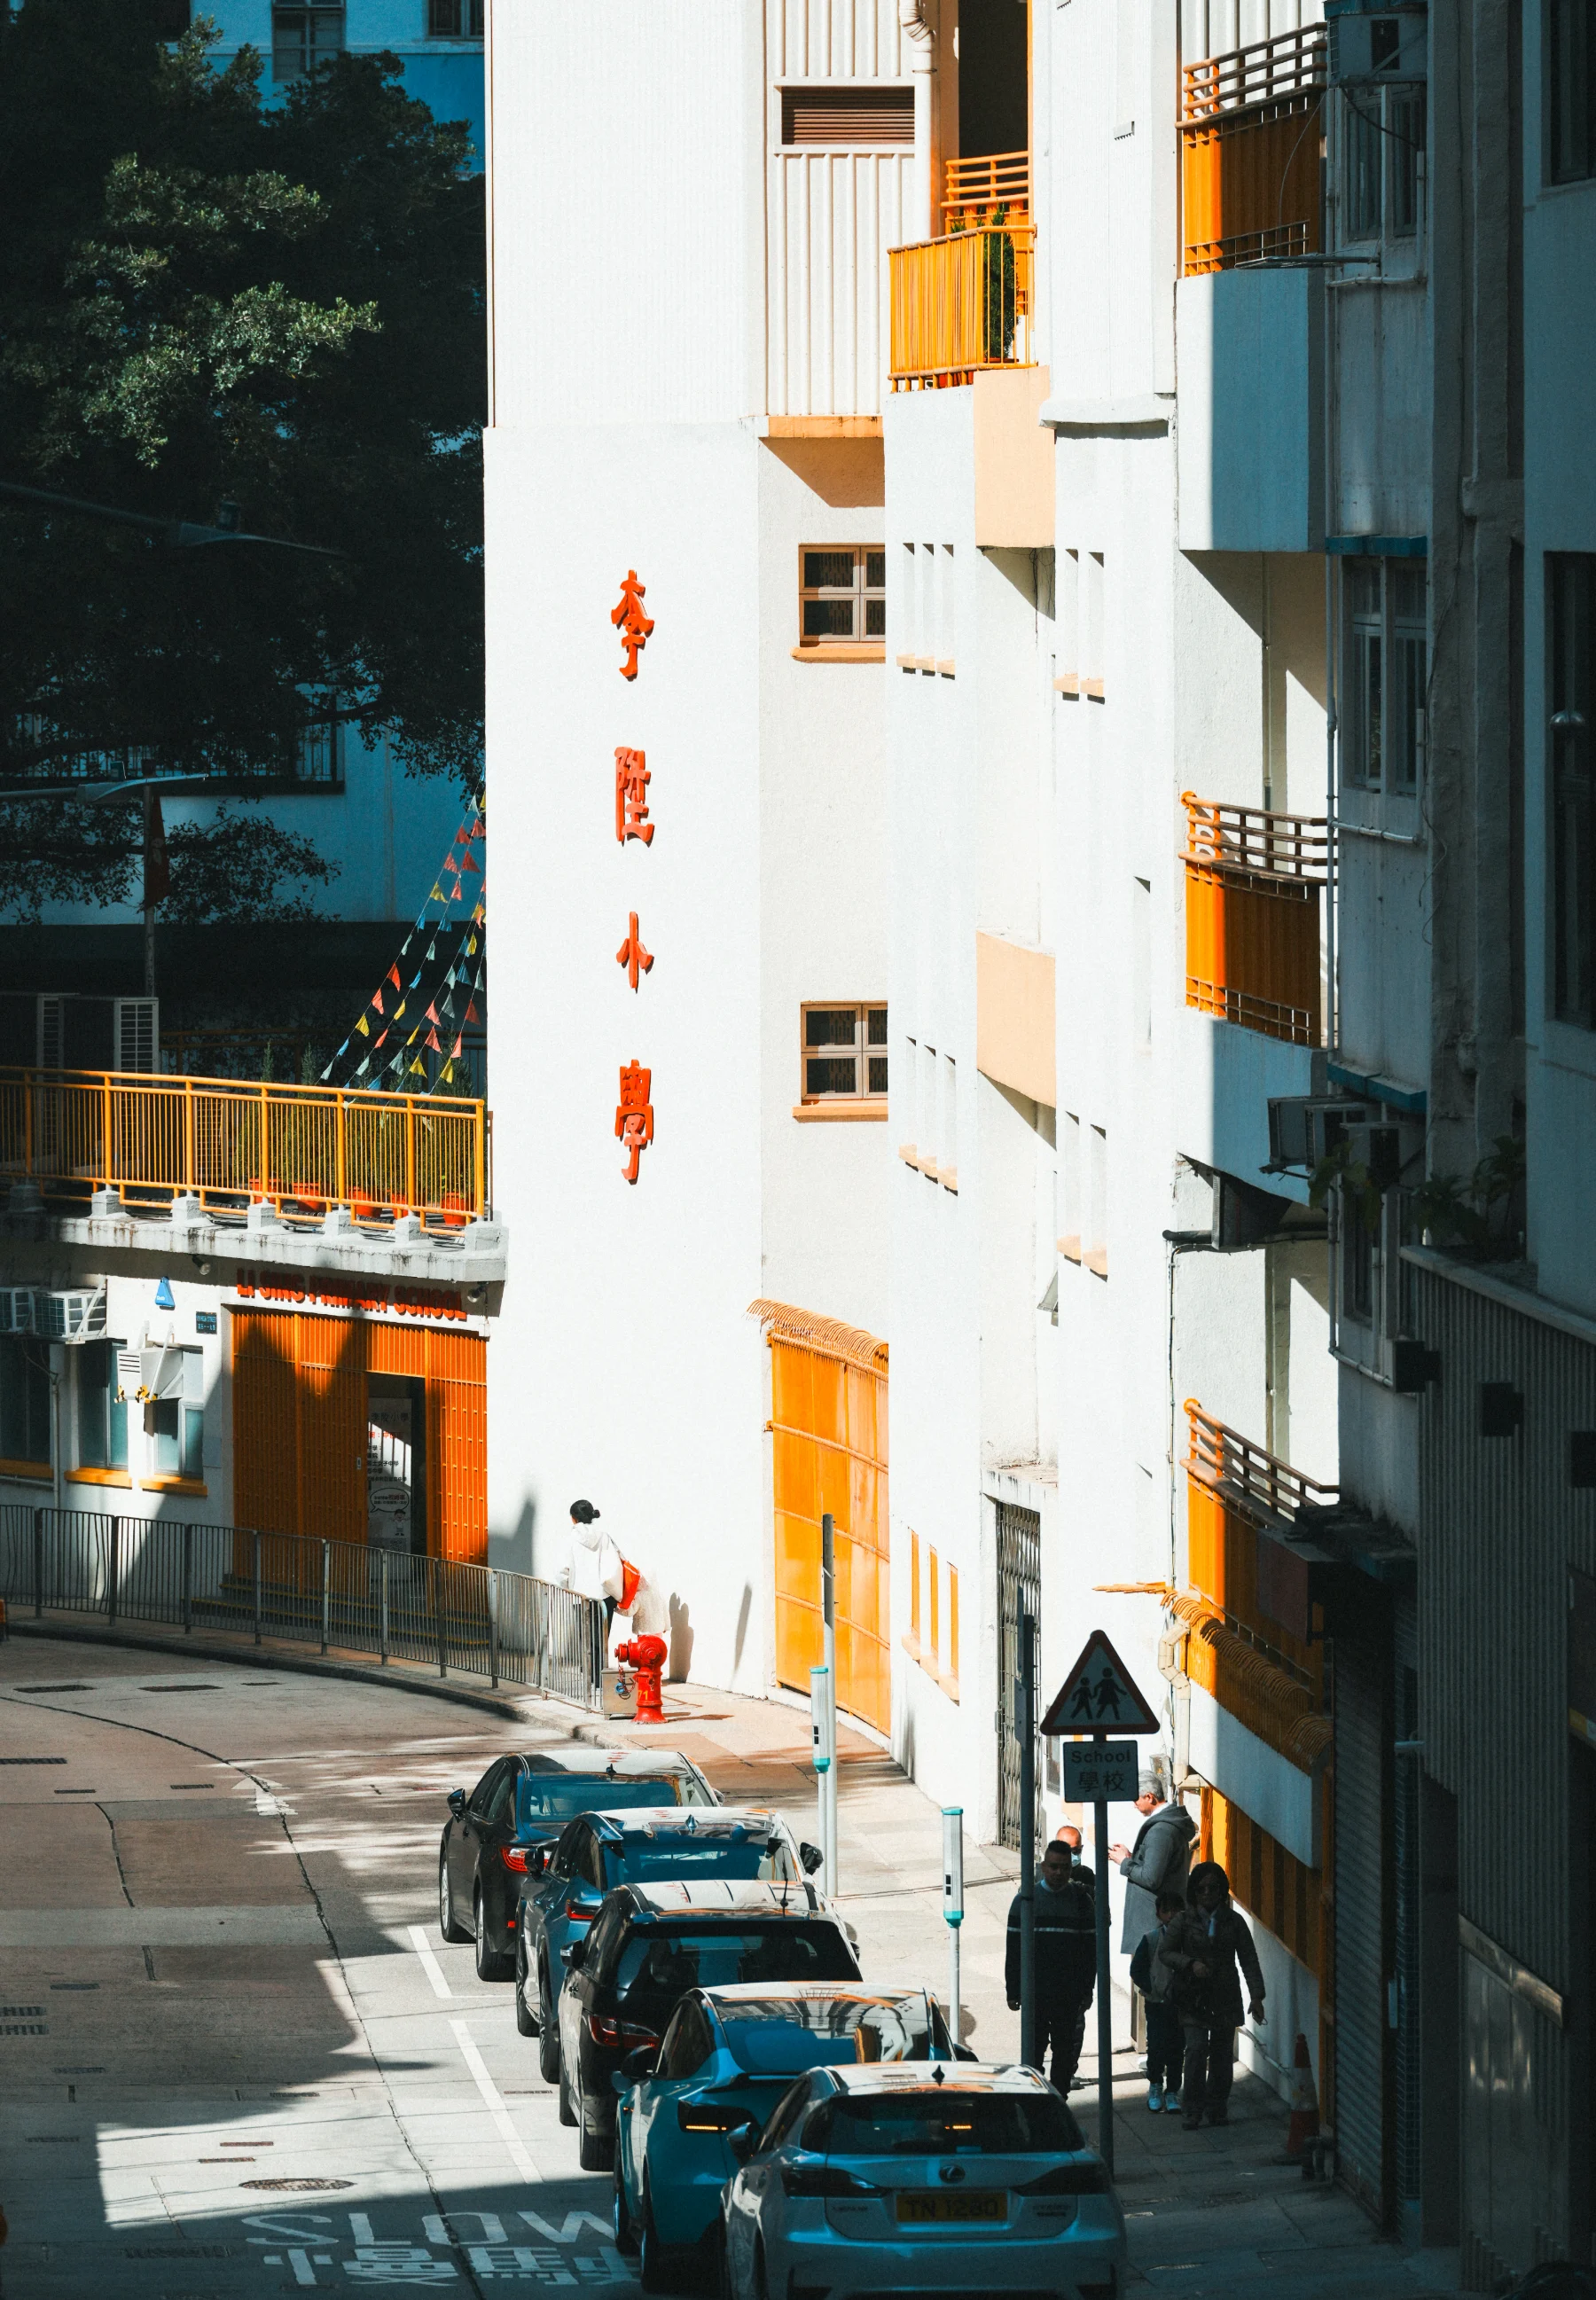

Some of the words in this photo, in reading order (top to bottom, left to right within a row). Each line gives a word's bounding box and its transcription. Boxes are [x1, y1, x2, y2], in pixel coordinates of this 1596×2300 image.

[611, 570, 654, 1182] 李陞小學
[237, 1268, 255, 1297] LI
[259, 1271, 304, 1303] SING
[308, 1276, 390, 1311] PRIMARY
[394, 1285, 466, 1320] SCHOOL
[1071, 1749, 1130, 1764] School
[1078, 1771, 1125, 1792] 學校
[904, 2200, 936, 2217] TN
[240, 2210, 615, 2245] SLOW
